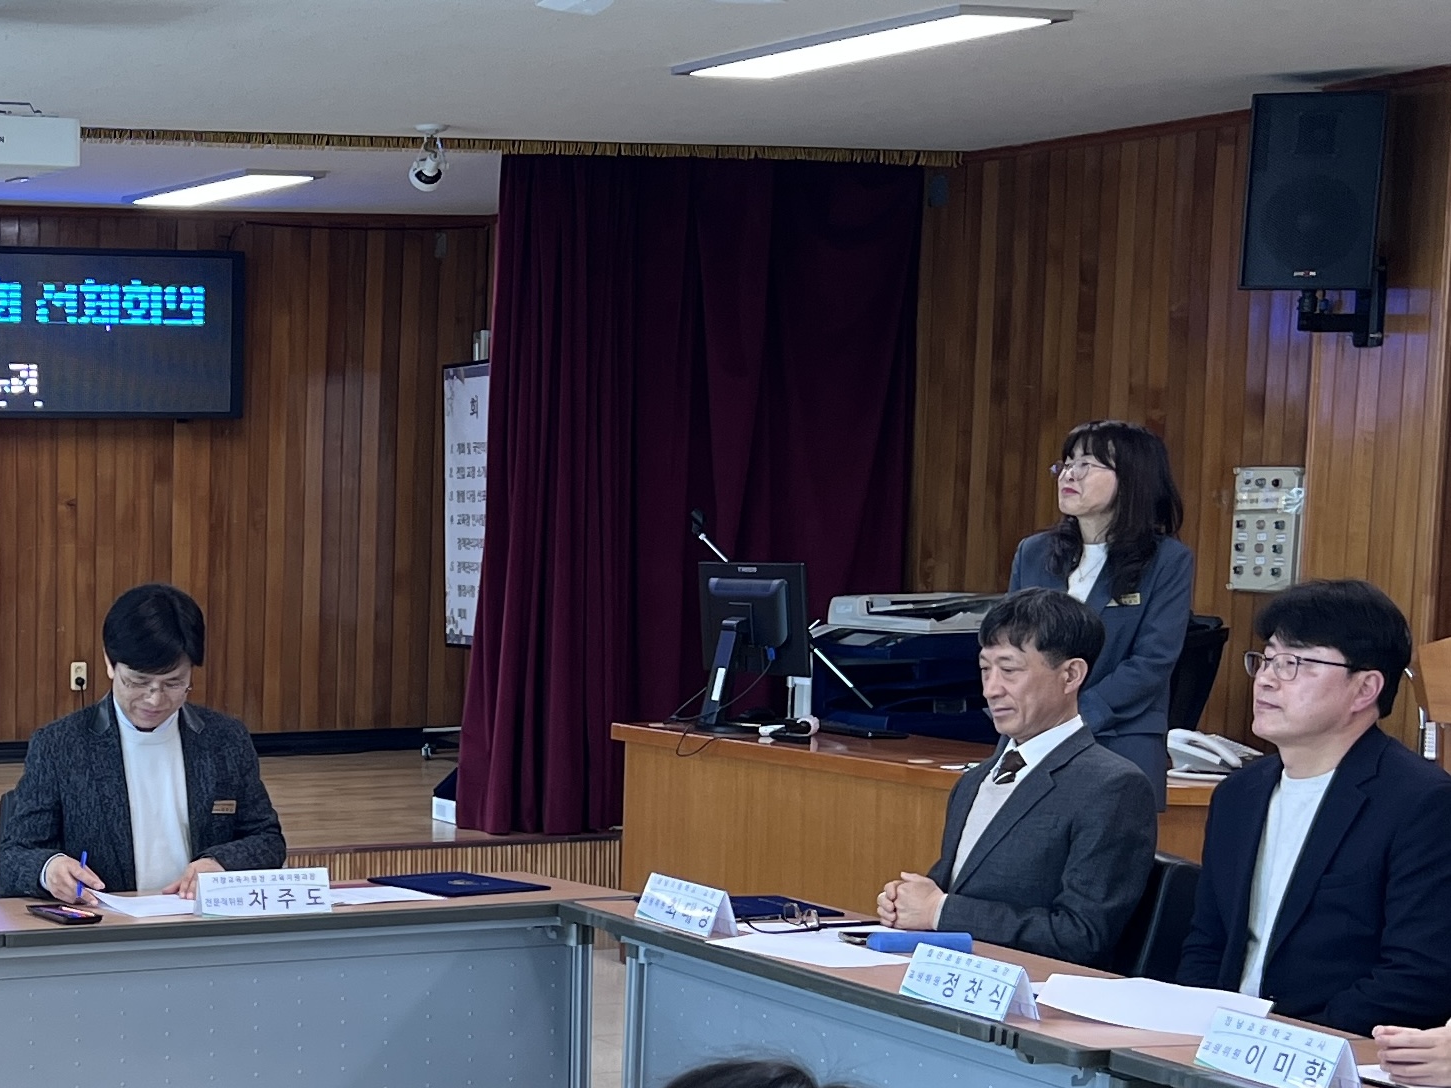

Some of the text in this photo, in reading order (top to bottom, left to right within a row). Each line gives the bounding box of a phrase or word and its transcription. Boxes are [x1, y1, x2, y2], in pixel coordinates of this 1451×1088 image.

[247, 886, 325, 910] 차주도
[942, 972, 1007, 1011] 정찬식
[1245, 1045, 1327, 1088] 이미향
